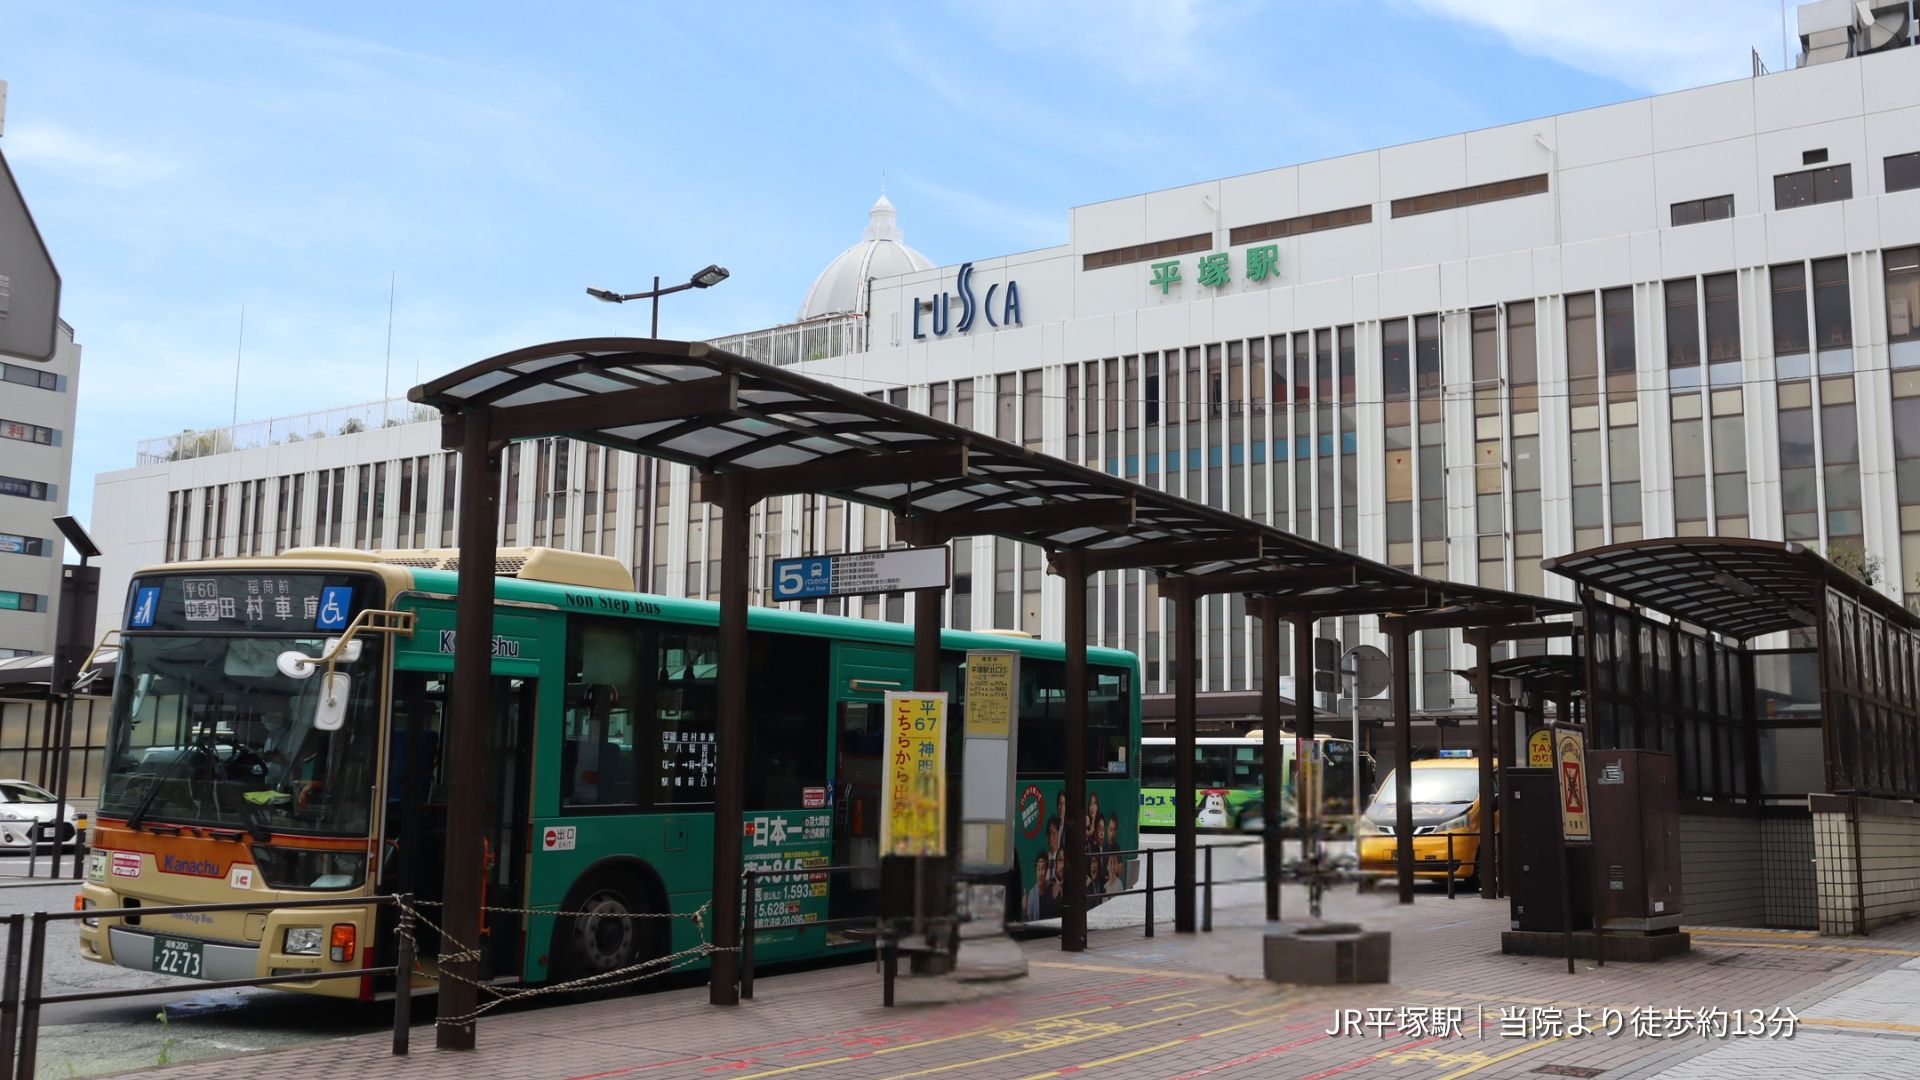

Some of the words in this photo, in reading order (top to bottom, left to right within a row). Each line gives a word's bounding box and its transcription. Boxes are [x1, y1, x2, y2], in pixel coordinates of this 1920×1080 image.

[1149, 243, 1281, 295] 平塚駅
[913, 262, 1022, 340] LUSCA
[185, 582, 216, 598] 平60
[247, 579, 289, 595] 稲荷前
[779, 563, 804, 594] 5
[186, 601, 218, 617] 中乗り
[219, 595, 319, 620] 田村車庫
[565, 592, 594, 606] Non
[599, 595, 630, 614] Step
[635, 600, 661, 615] Bus
[557, 828, 574, 840] 出口
[753, 815, 803, 847] 日本一
[164, 854, 221, 876] Kanachu
